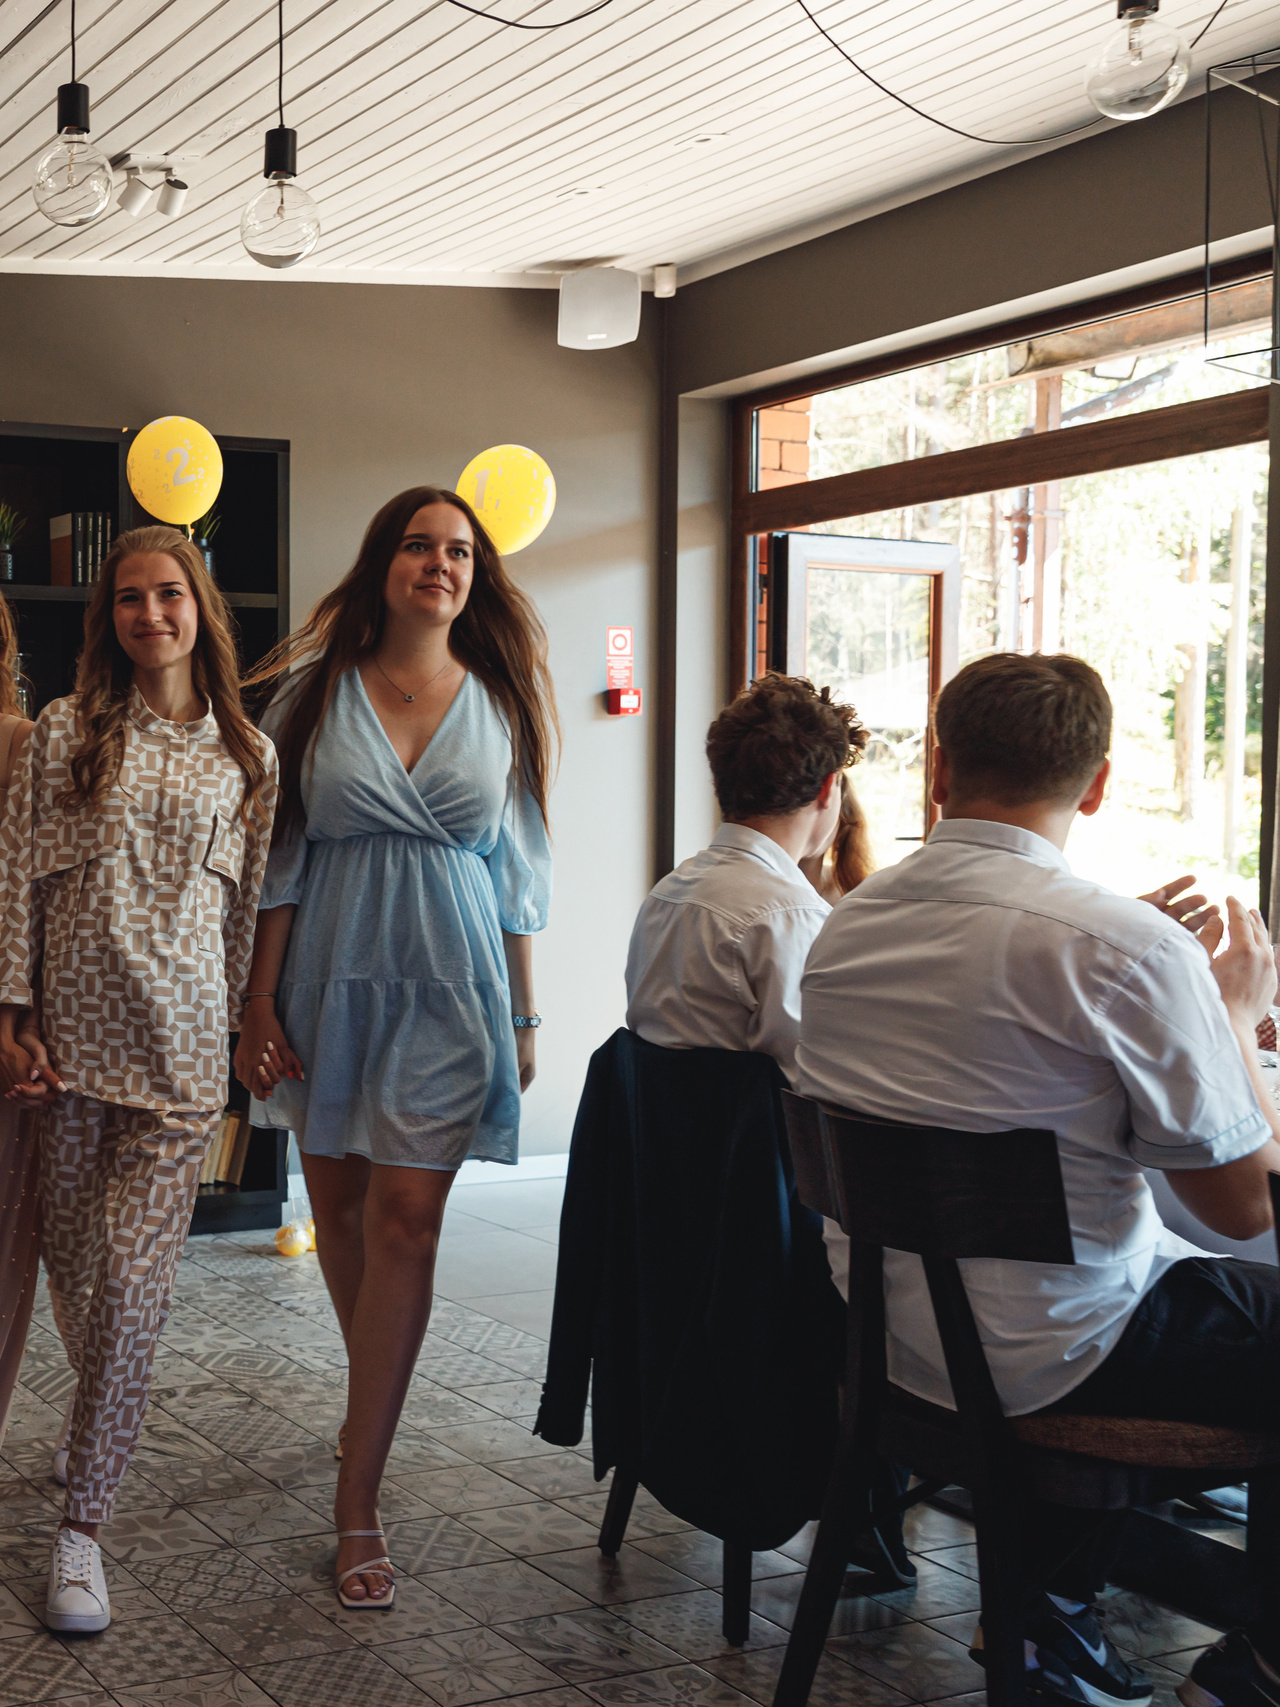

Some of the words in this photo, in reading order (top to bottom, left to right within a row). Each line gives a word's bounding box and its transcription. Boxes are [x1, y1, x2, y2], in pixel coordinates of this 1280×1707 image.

[183, 439, 193, 450] 2
[153, 448, 161, 460] 2
[165, 447, 197, 488] 2
[197, 467, 205, 479] 2
[163, 483, 172, 494] 2
[474, 468, 491, 510] 1
